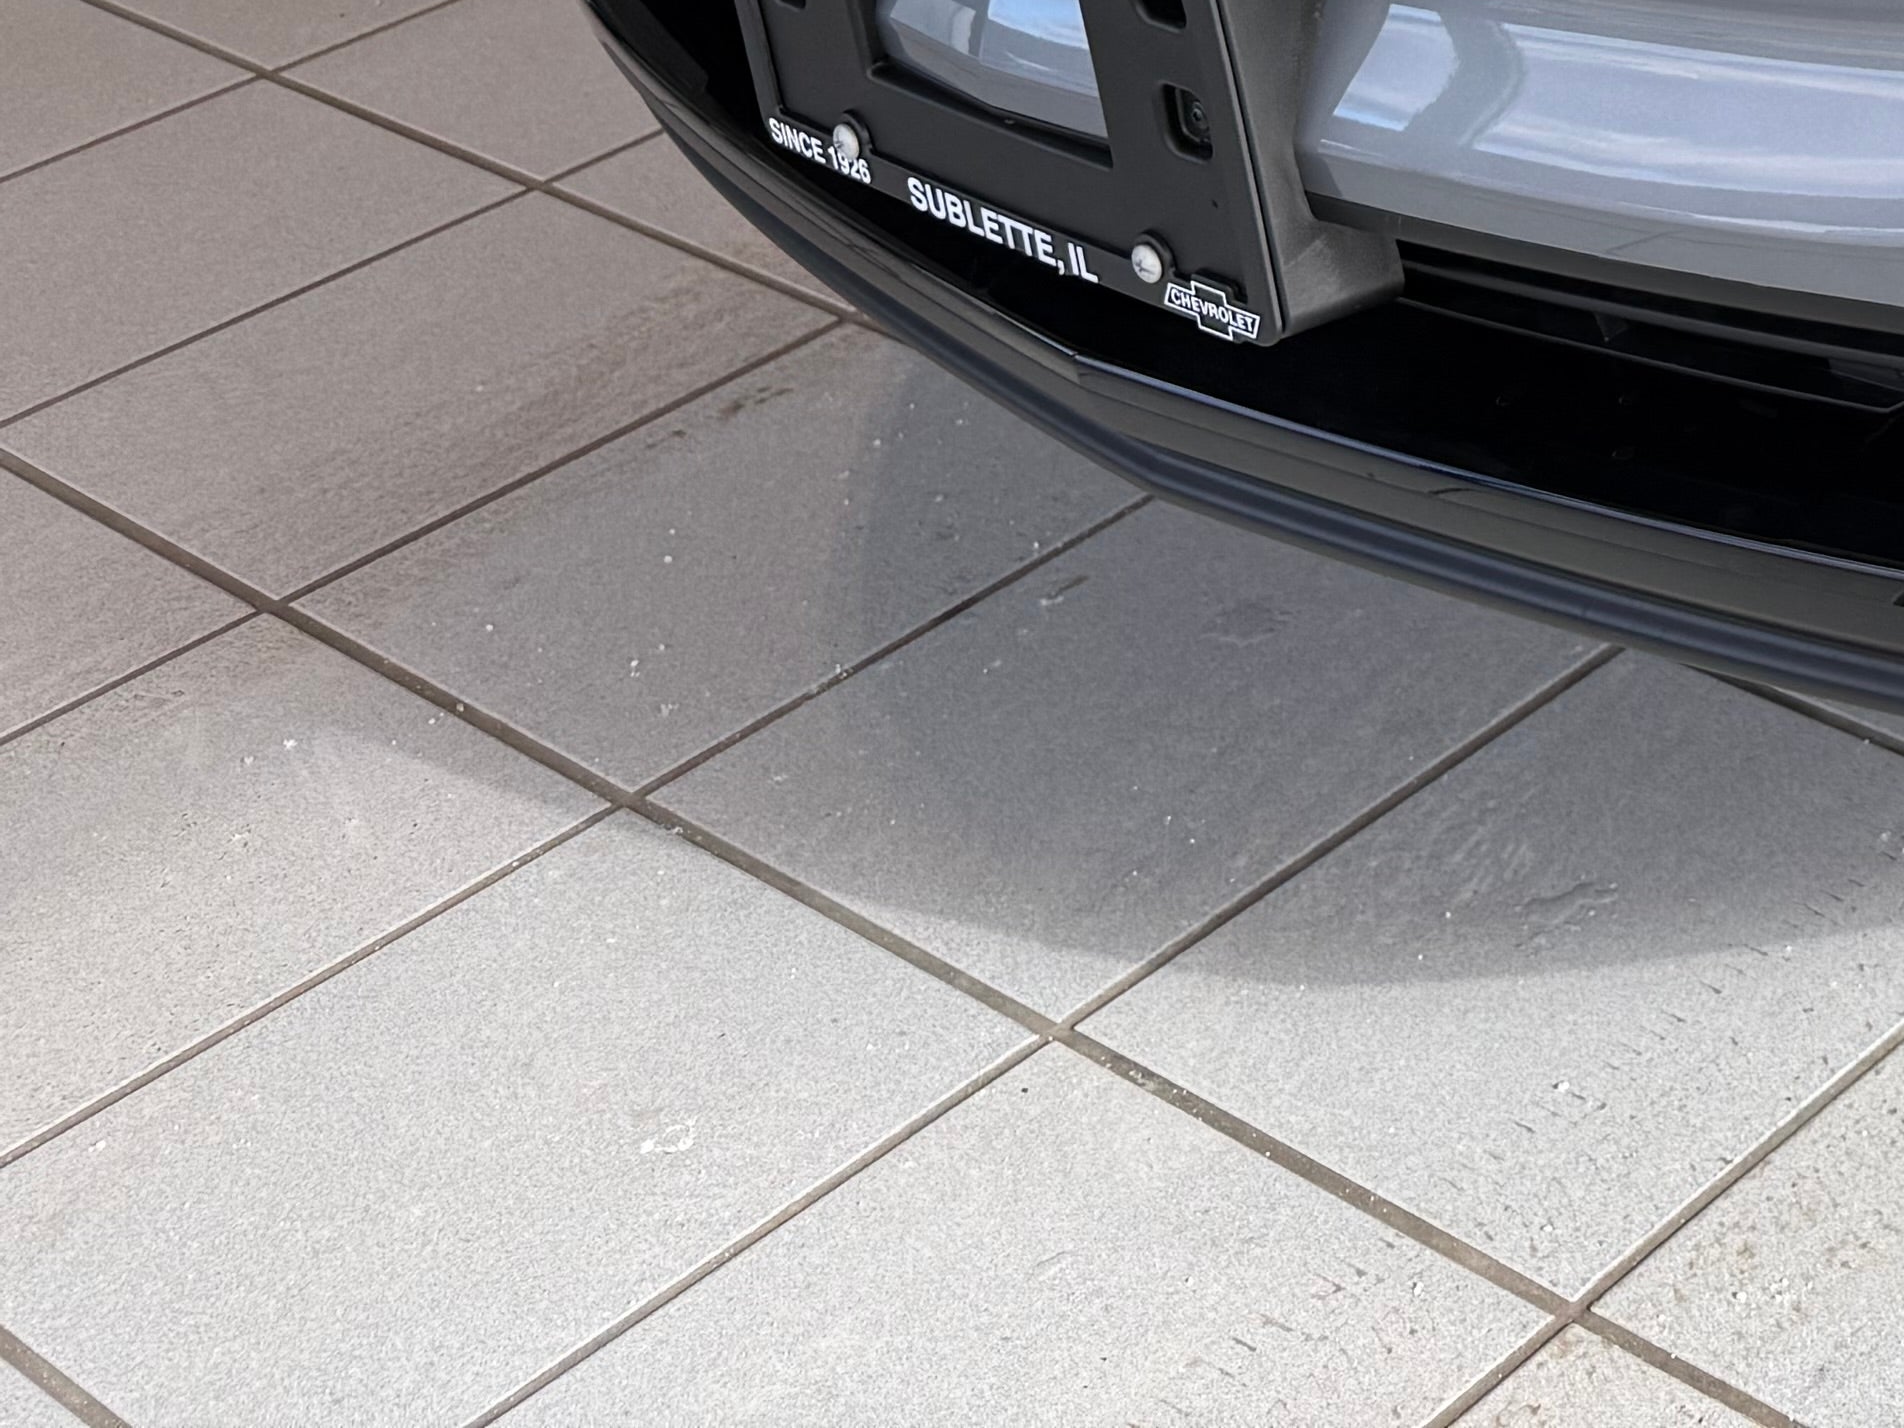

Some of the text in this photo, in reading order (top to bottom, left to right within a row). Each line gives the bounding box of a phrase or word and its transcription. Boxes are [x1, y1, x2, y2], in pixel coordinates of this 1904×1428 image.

[768, 117, 871, 184] SINCE 1926
[907, 176, 1099, 284] SUBLETTE, IL
[1170, 288, 1253, 333] CHEVROLET
